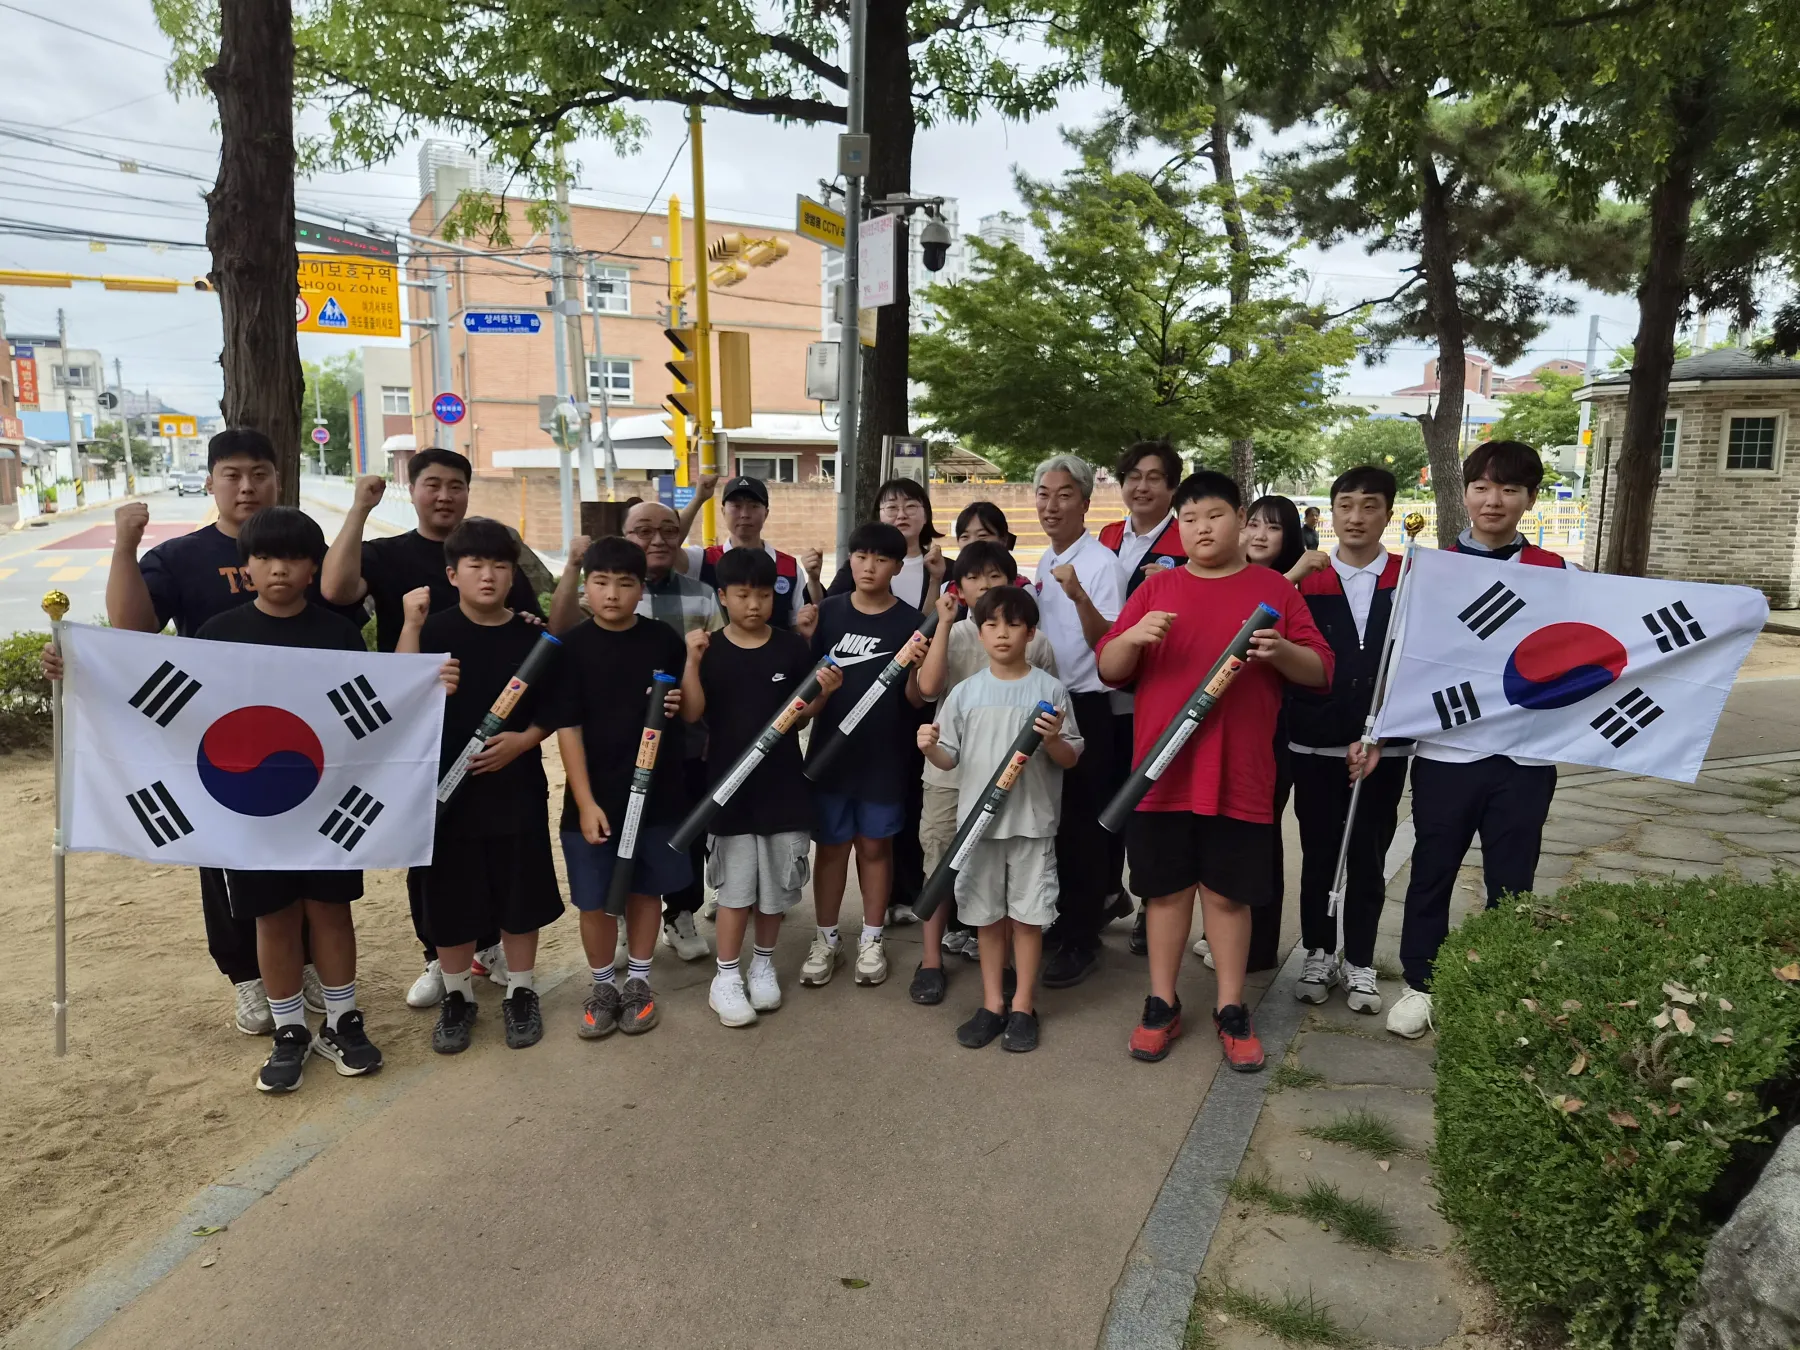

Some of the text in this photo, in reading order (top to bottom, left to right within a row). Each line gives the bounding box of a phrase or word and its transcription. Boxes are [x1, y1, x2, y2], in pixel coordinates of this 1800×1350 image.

[822, 219, 840, 237] CCTV
[349, 283, 388, 295] ZONE
[835, 632, 882, 656] NIKE
